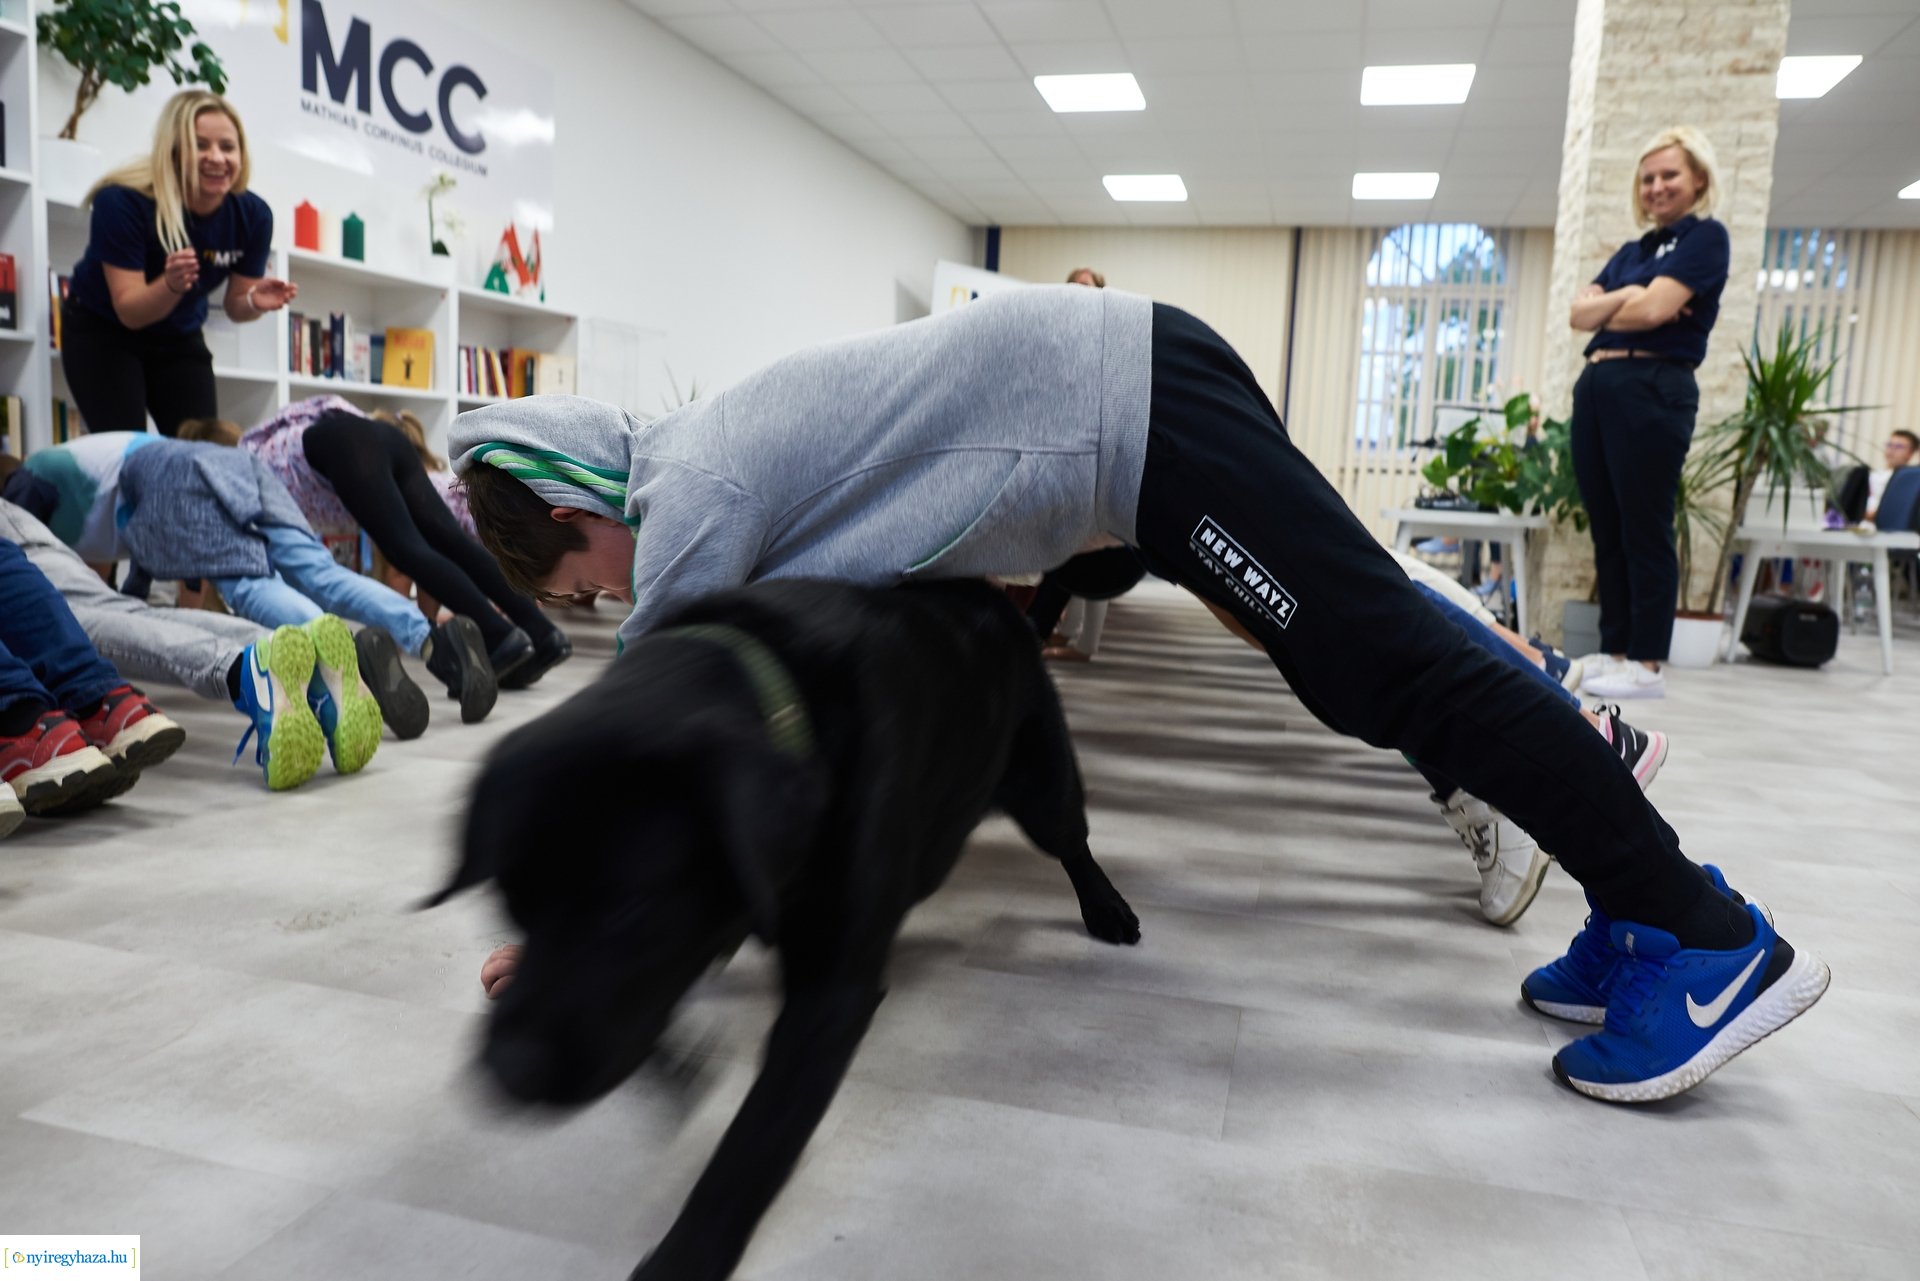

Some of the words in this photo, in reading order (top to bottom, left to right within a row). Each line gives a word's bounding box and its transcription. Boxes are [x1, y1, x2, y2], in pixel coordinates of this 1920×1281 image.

[301, 0, 488, 154] MCC
[301, 98, 358, 131] MATHIAS
[363, 121, 423, 154] CORVINUS
[1200, 527, 1244, 568] NEW
[1243, 565, 1290, 618] WAYZ
